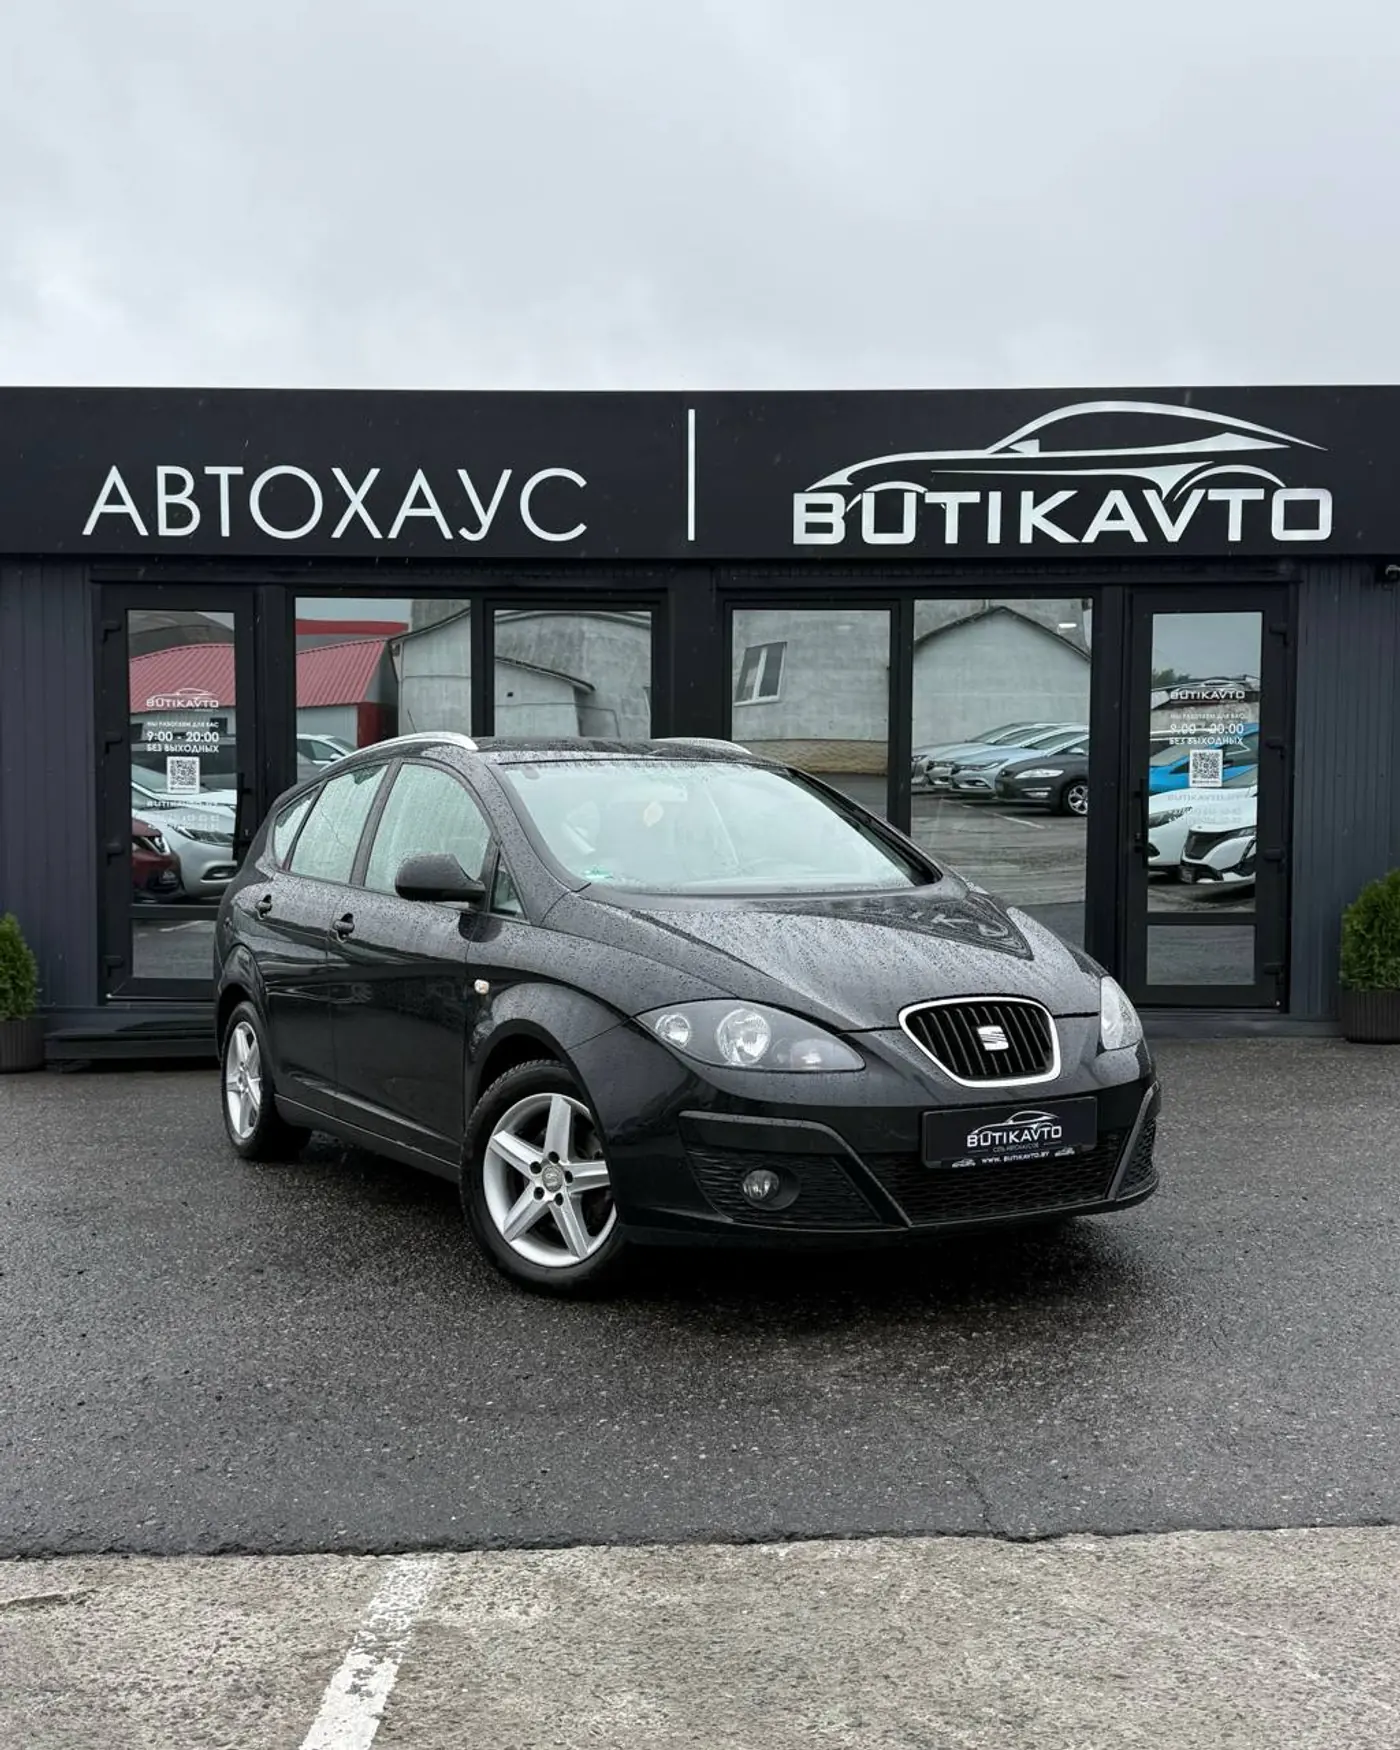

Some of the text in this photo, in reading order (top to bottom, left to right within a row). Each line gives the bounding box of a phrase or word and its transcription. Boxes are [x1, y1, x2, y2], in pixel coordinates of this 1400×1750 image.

[82, 465, 588, 542] АВТОХАУС
[793, 488, 1333, 545] BUTIKAVTO
[1170, 691, 1245, 699] BUTIKAVTO
[146, 698, 219, 708] BUTIKAVTO
[147, 731, 173, 742] 9:00
[186, 731, 219, 742] 20:00
[1169, 736, 1243, 745] БЕЗ ВЫХОДНЫХ
[147, 744, 219, 753] БЕЗ ВЫХОДНЫХ
[967, 1126, 1062, 1147] BUTIKAVTO
